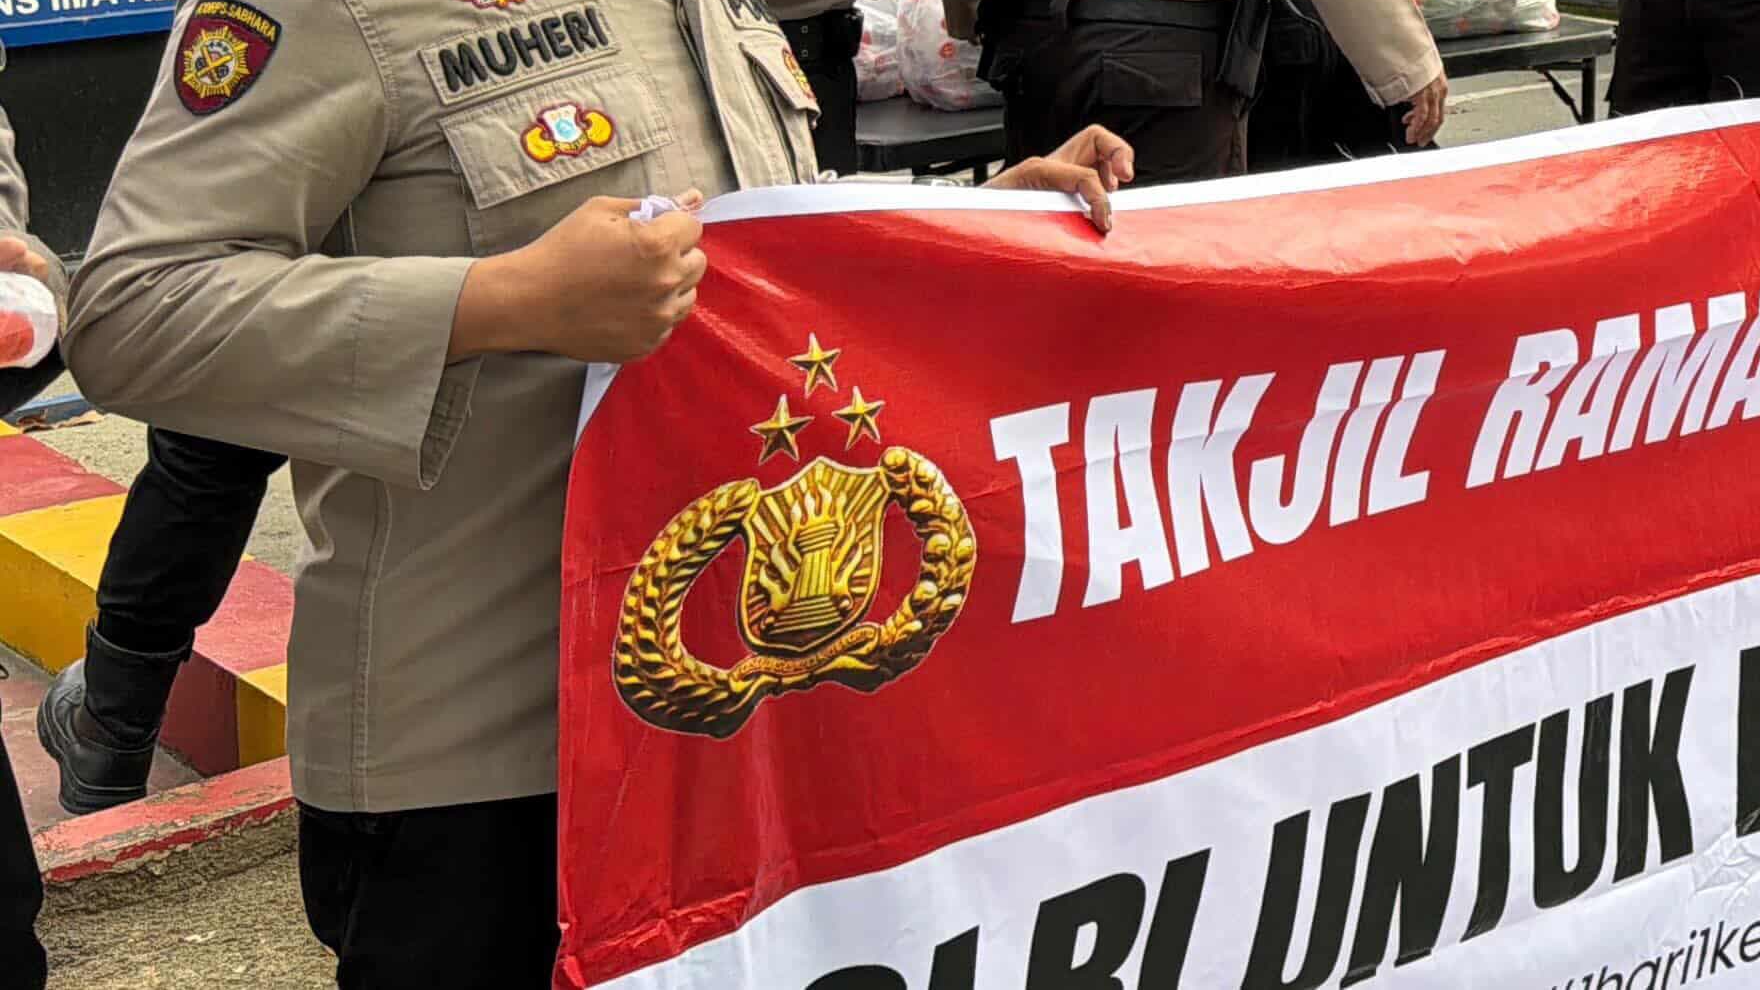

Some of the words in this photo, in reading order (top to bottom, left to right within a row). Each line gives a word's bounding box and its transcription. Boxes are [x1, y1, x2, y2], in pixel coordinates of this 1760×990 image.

[438, 6, 609, 93] MUHERI
[989, 349, 1447, 624] TAKJIL
[806, 848, 1211, 990] RI
[1240, 665, 1695, 990] UNTUK
